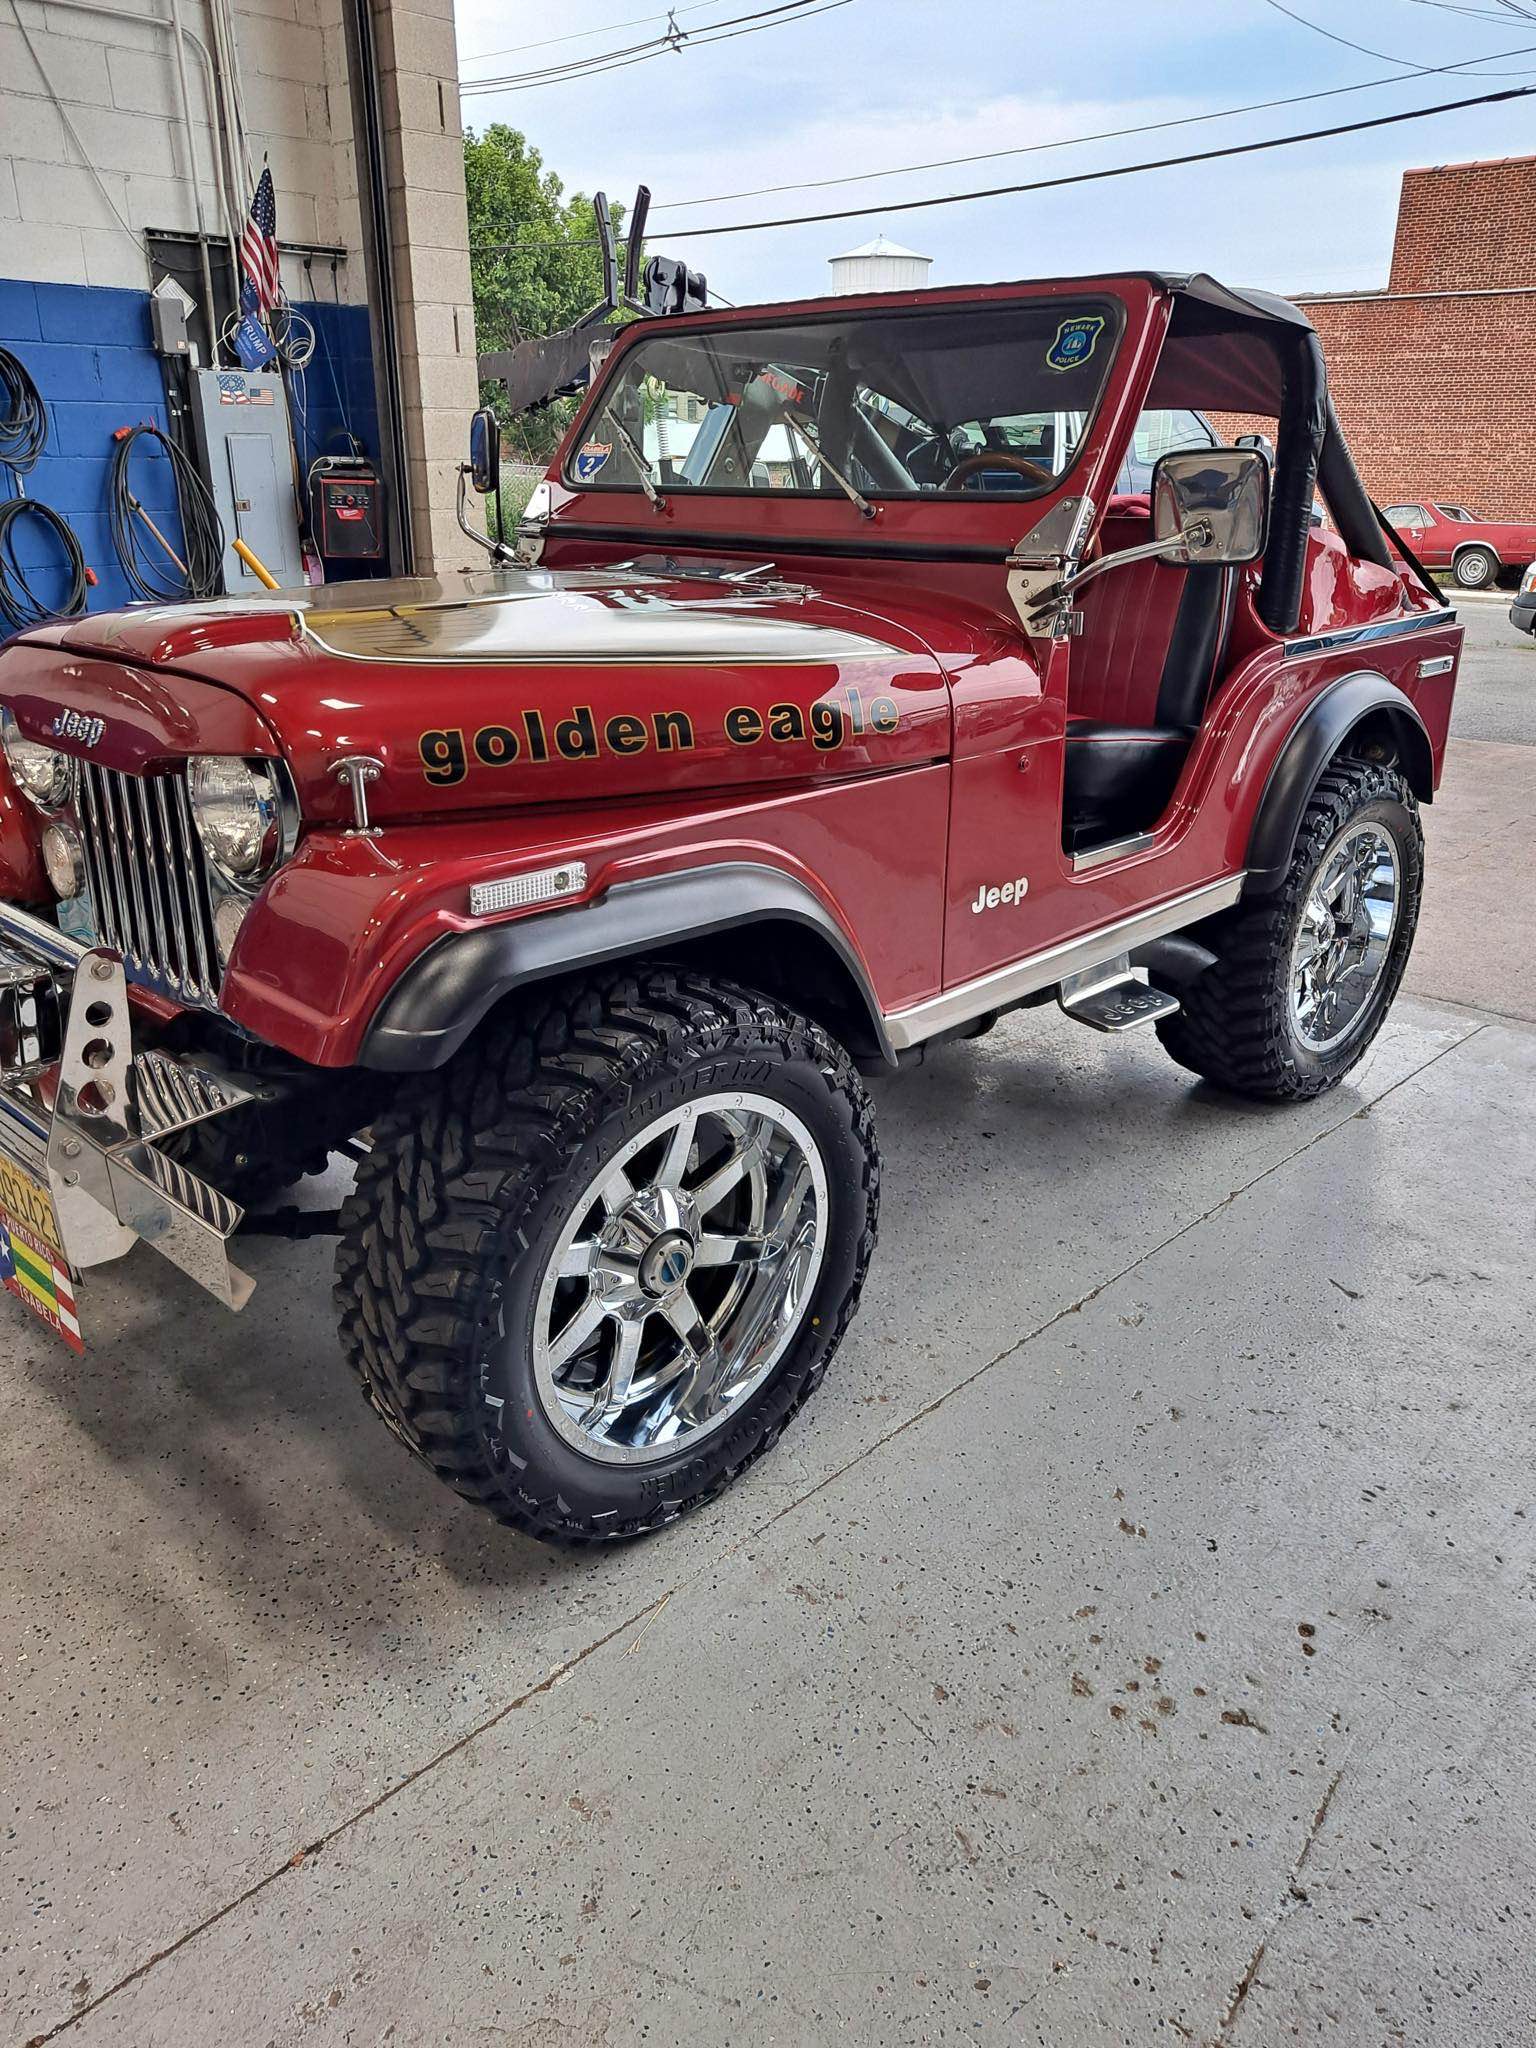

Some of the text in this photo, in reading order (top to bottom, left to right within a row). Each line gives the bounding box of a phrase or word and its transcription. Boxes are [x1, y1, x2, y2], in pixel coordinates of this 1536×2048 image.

[242, 318, 267, 354] TRUMP
[1064, 324, 1096, 334] NEWARK
[1054, 355, 1080, 364] POLICE
[582, 457, 595, 473] 2
[53, 708, 106, 748] Jeep
[418, 687, 900, 787] golden eagle
[971, 876, 1029, 914] Jeep
[20, 1286, 63, 1335] ISABELA
